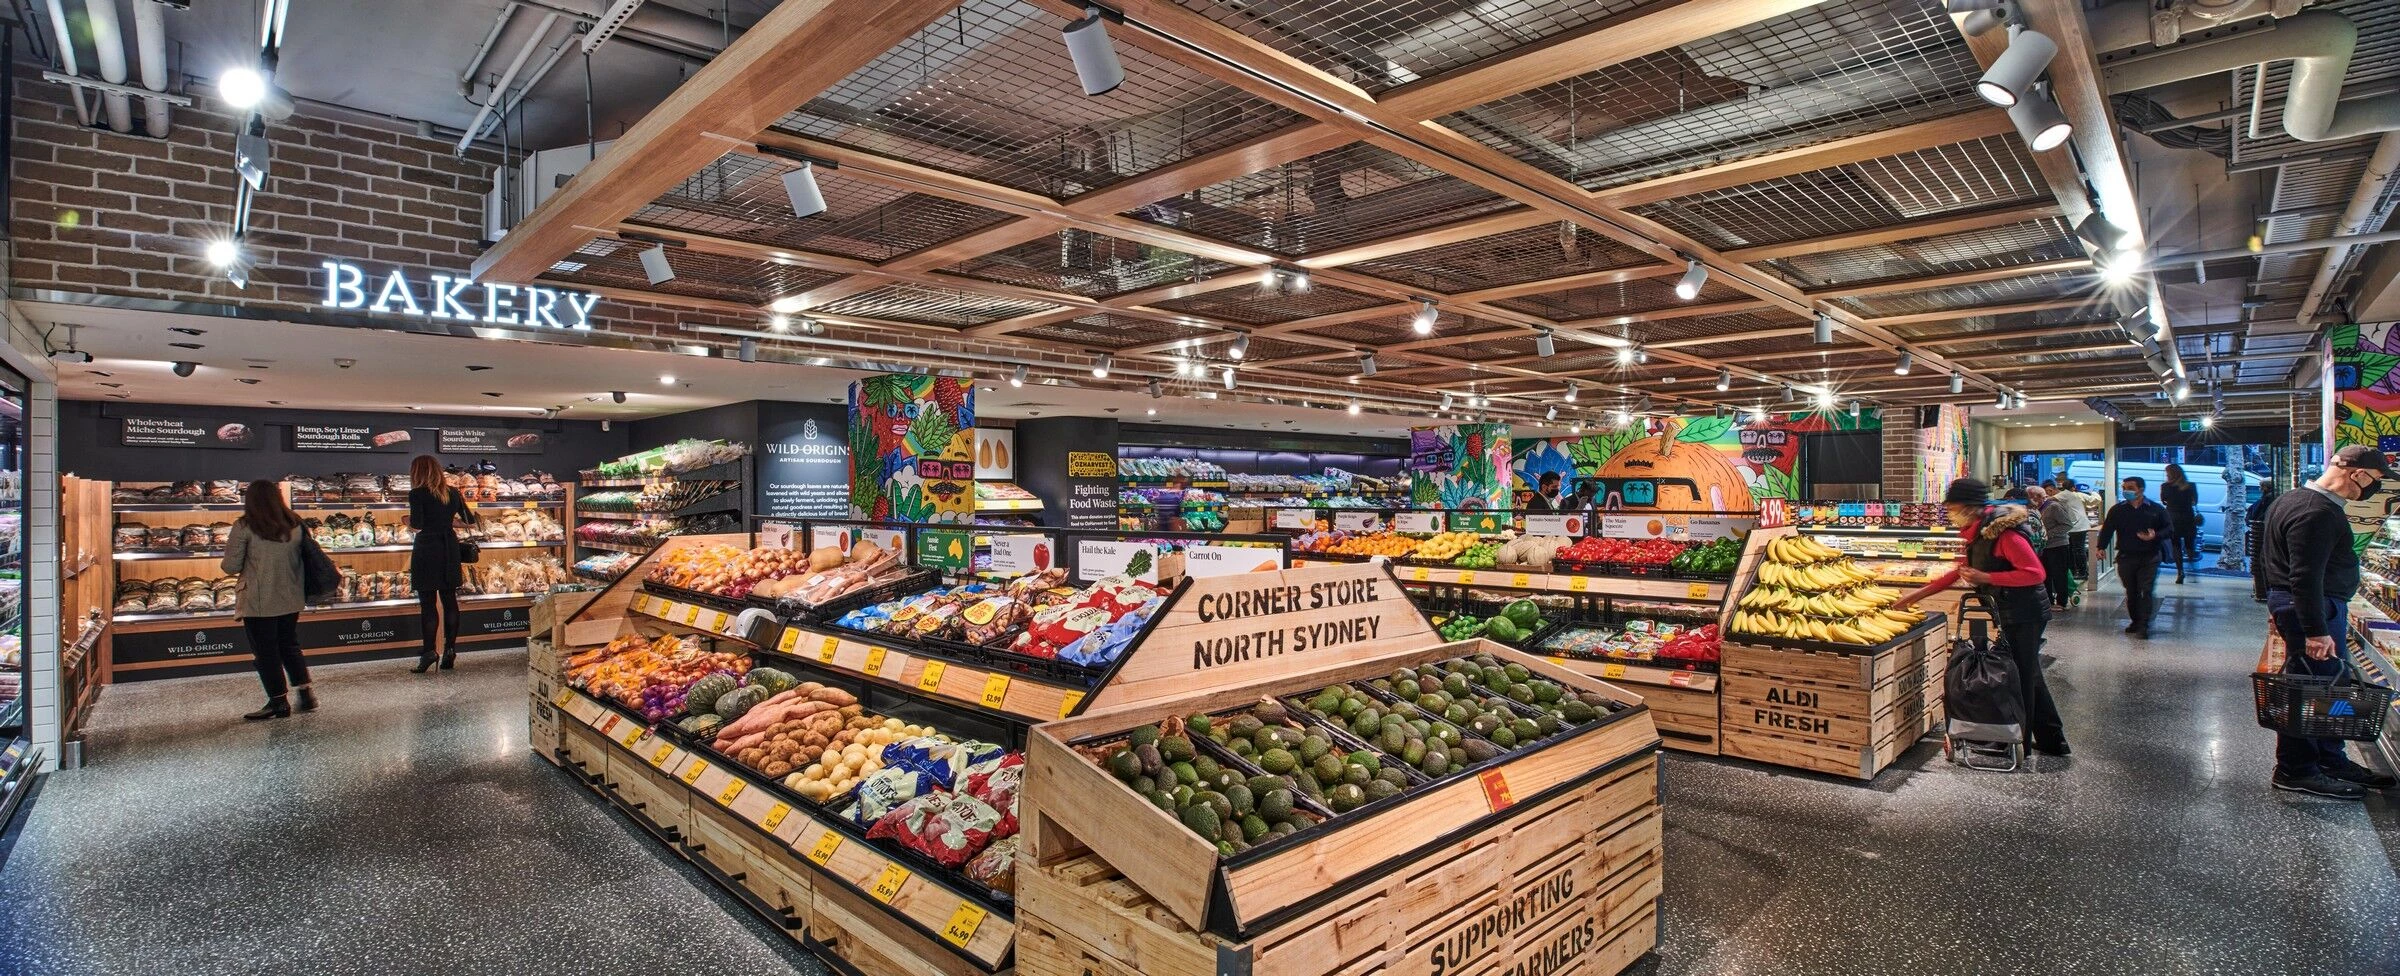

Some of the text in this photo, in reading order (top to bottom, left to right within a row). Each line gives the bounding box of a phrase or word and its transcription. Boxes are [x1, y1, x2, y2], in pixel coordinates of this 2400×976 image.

[322, 262, 601, 331] BAKERY
[127, 418, 183, 428] Wholewheat
[127, 426, 206, 436] Miche Sourdough
[297, 426, 323, 435] Hemp,
[324, 426, 338, 435] Soy
[297, 433, 340, 441] Sourdough
[766, 443, 800, 455] WILD
[1075, 484, 1110, 497] Fighting
[1070, 498, 1117, 509] Food Waste
[993, 539, 1006, 547] Never
[993, 548, 1012, 556] Bad One
[1082, 545, 1117, 555] Hail the Kale
[1189, 550, 1222, 561] Carrot On
[1198, 577, 1379, 623] CORNER STORE
[338, 633, 359, 641] WILD
[361, 630, 394, 639] ORIGINS
[168, 642, 233, 653] WILD ORIGINS
[1194, 615, 1381, 670] NORTH SYDNEY
[538, 680, 549, 700] ALDI
[1765, 687, 1819, 709] ALDI
[536, 700, 553, 723] FRESH
[1754, 709, 1830, 734] FRESH
[877, 884, 894, 897] $5.99
[1431, 868, 1574, 976] SUPPORTING
[949, 925, 969, 940] $4.99
